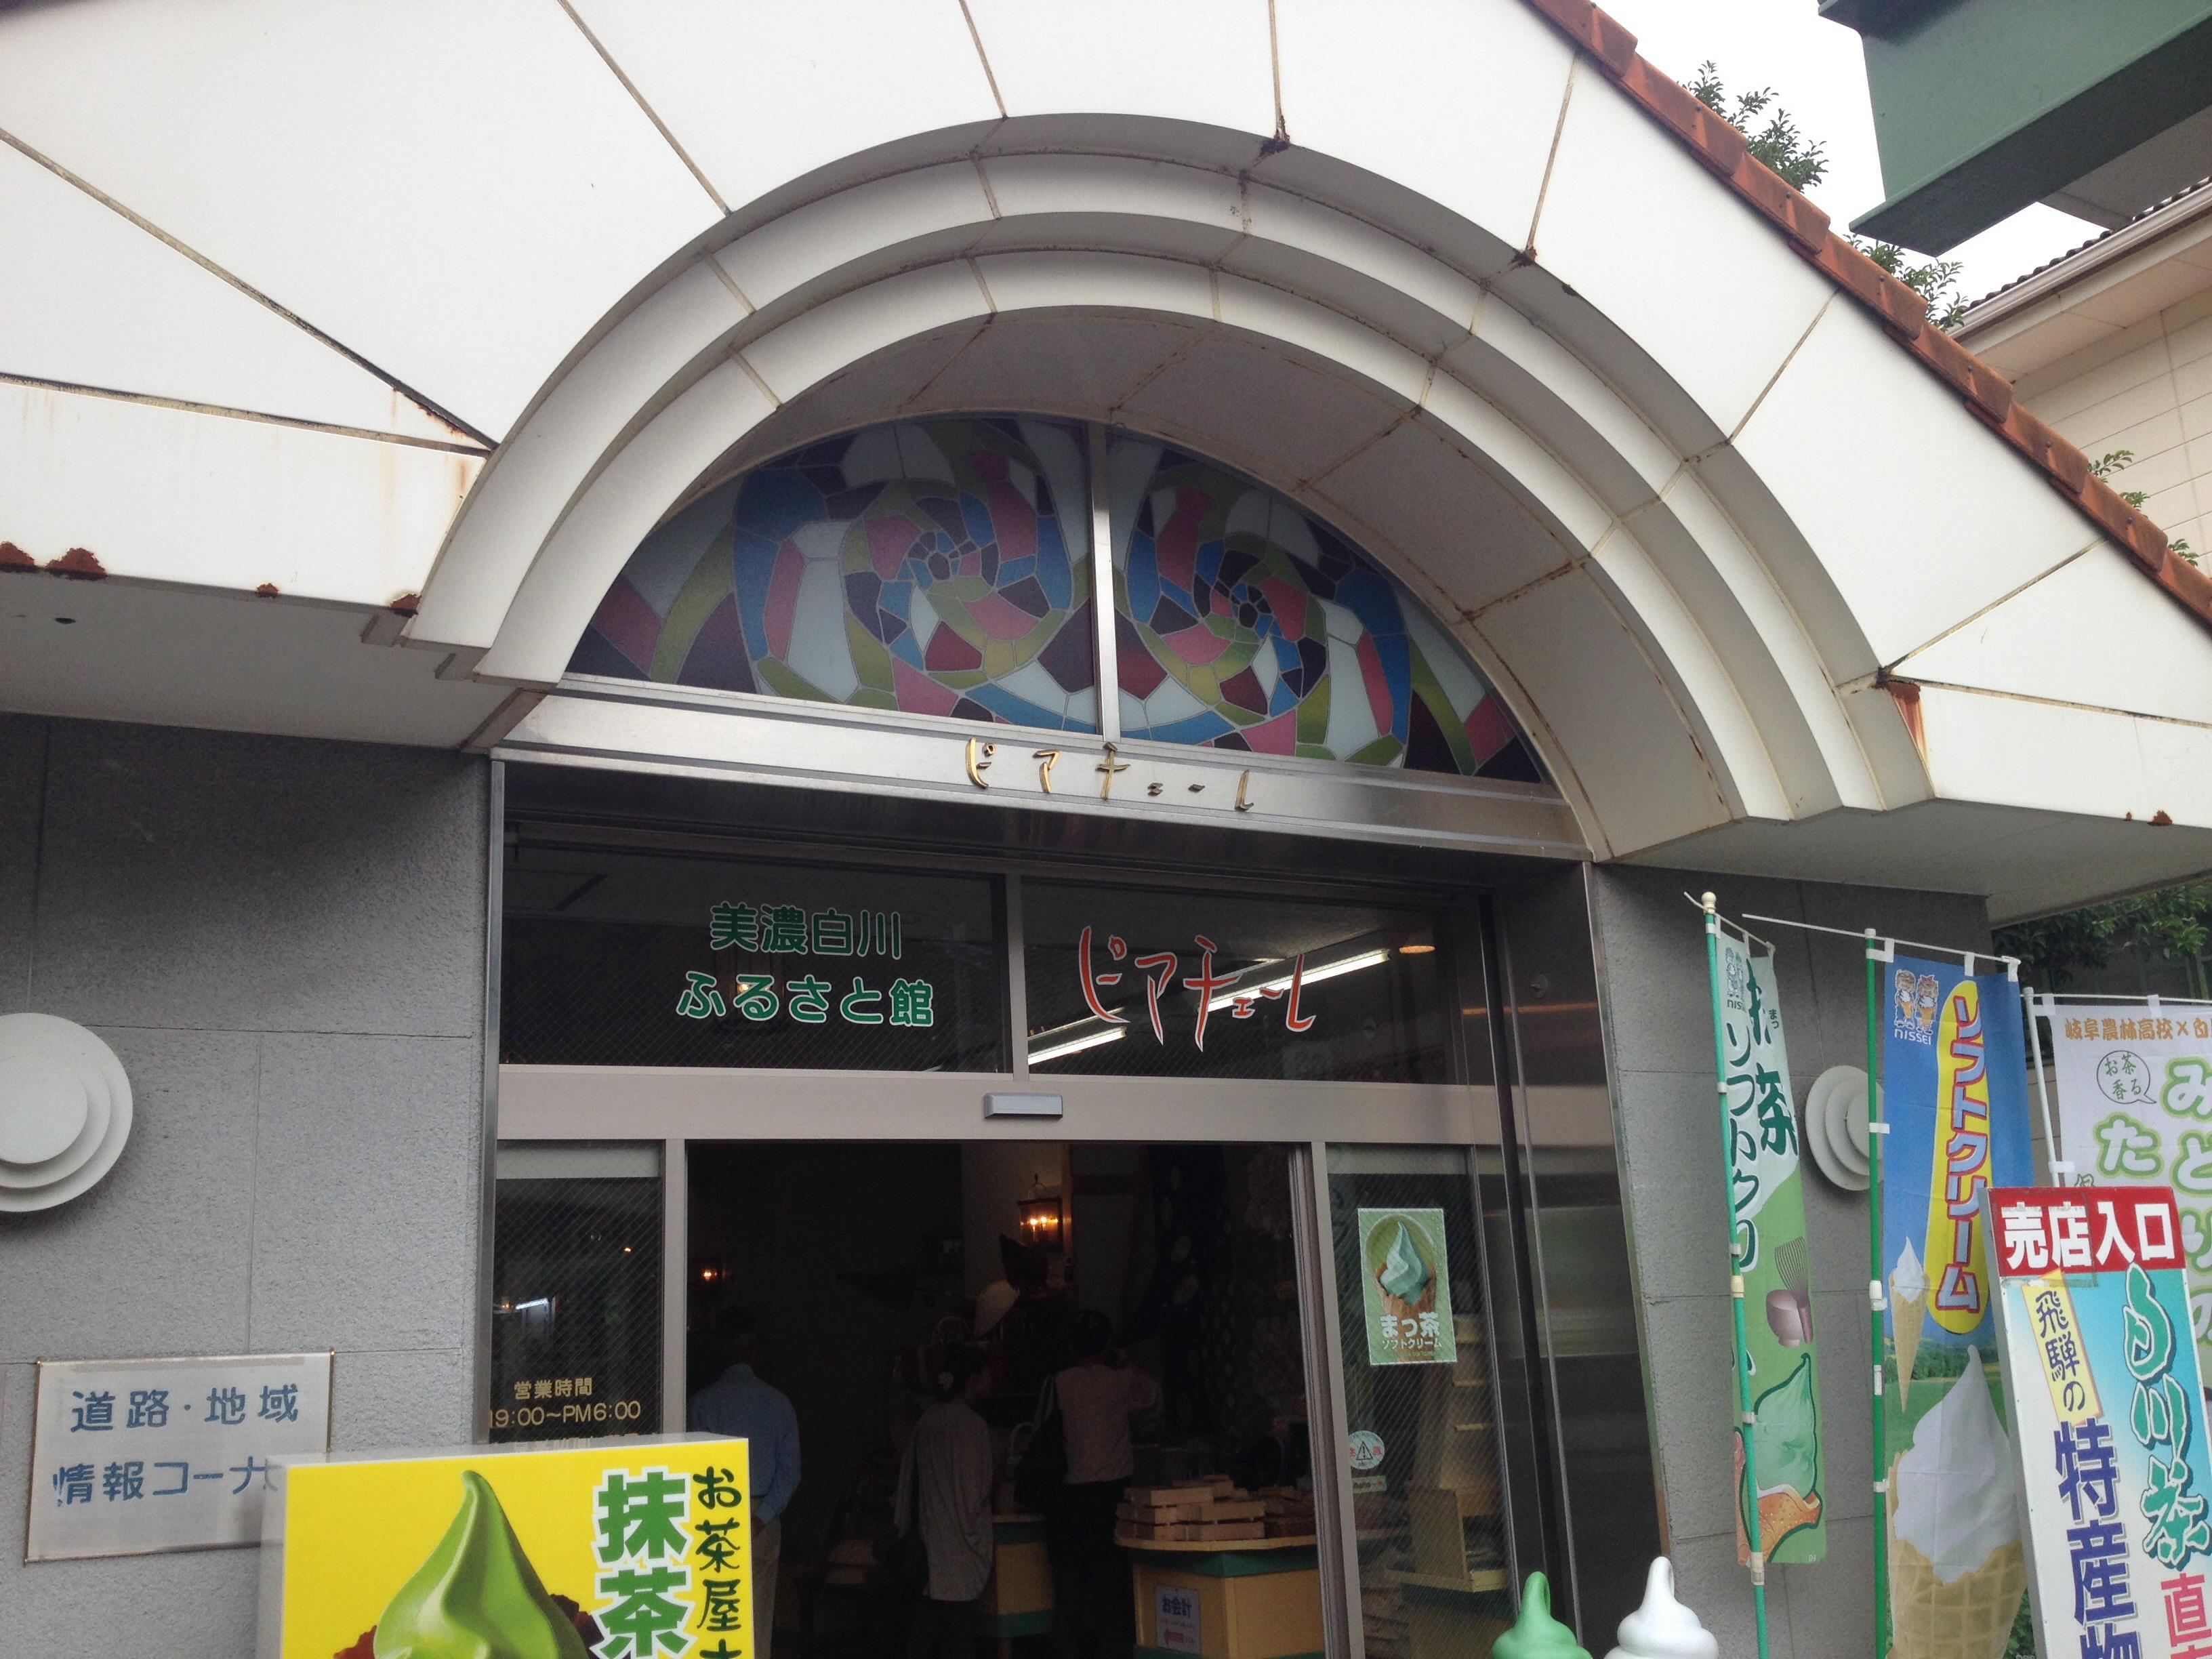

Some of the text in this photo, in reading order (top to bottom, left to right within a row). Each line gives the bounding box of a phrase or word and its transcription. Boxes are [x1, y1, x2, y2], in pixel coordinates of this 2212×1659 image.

[710, 901, 902, 960] 美濃白川
[676, 970, 934, 1027] ふるさと館
[2064, 1017, 2212, 1041] 岐阜農林高校×白
[2001, 1201, 2175, 1269] 売店入口
[1382, 1338, 1442, 1350] ソフトクリーム
[2036, 1290, 2087, 1412] 飛騨の
[70, 1384, 299, 1433] 道路・地域
[514, 1377, 593, 1400] 営業時間
[592, 1467, 694, 1659] 抹茶
